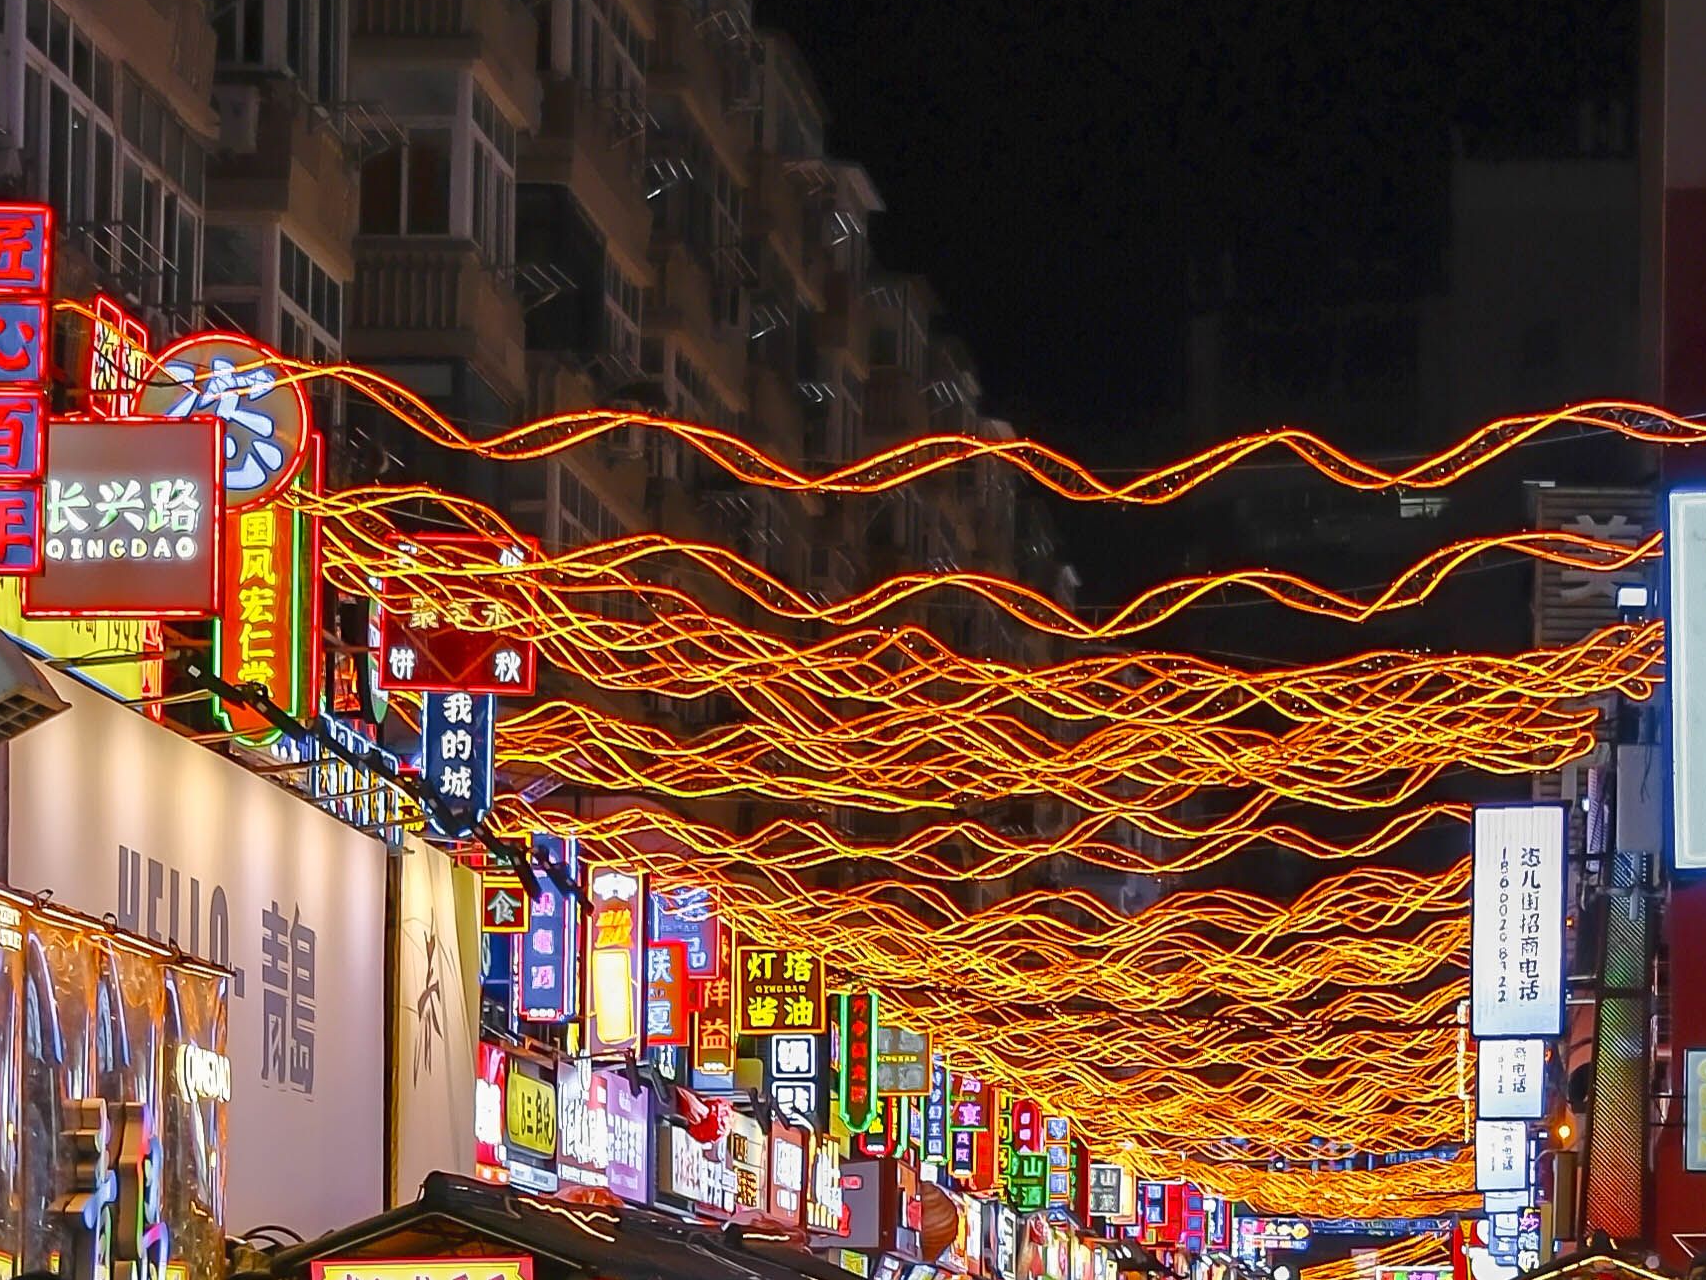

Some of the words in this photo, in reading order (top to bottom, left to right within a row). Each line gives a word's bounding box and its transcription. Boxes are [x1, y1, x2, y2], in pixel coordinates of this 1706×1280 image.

[46, 479, 201, 533] 长兴路
[46, 537, 199, 561] QINGDAO
[747, 951, 815, 983] 灯塔
[747, 996, 815, 1027] 酱油
